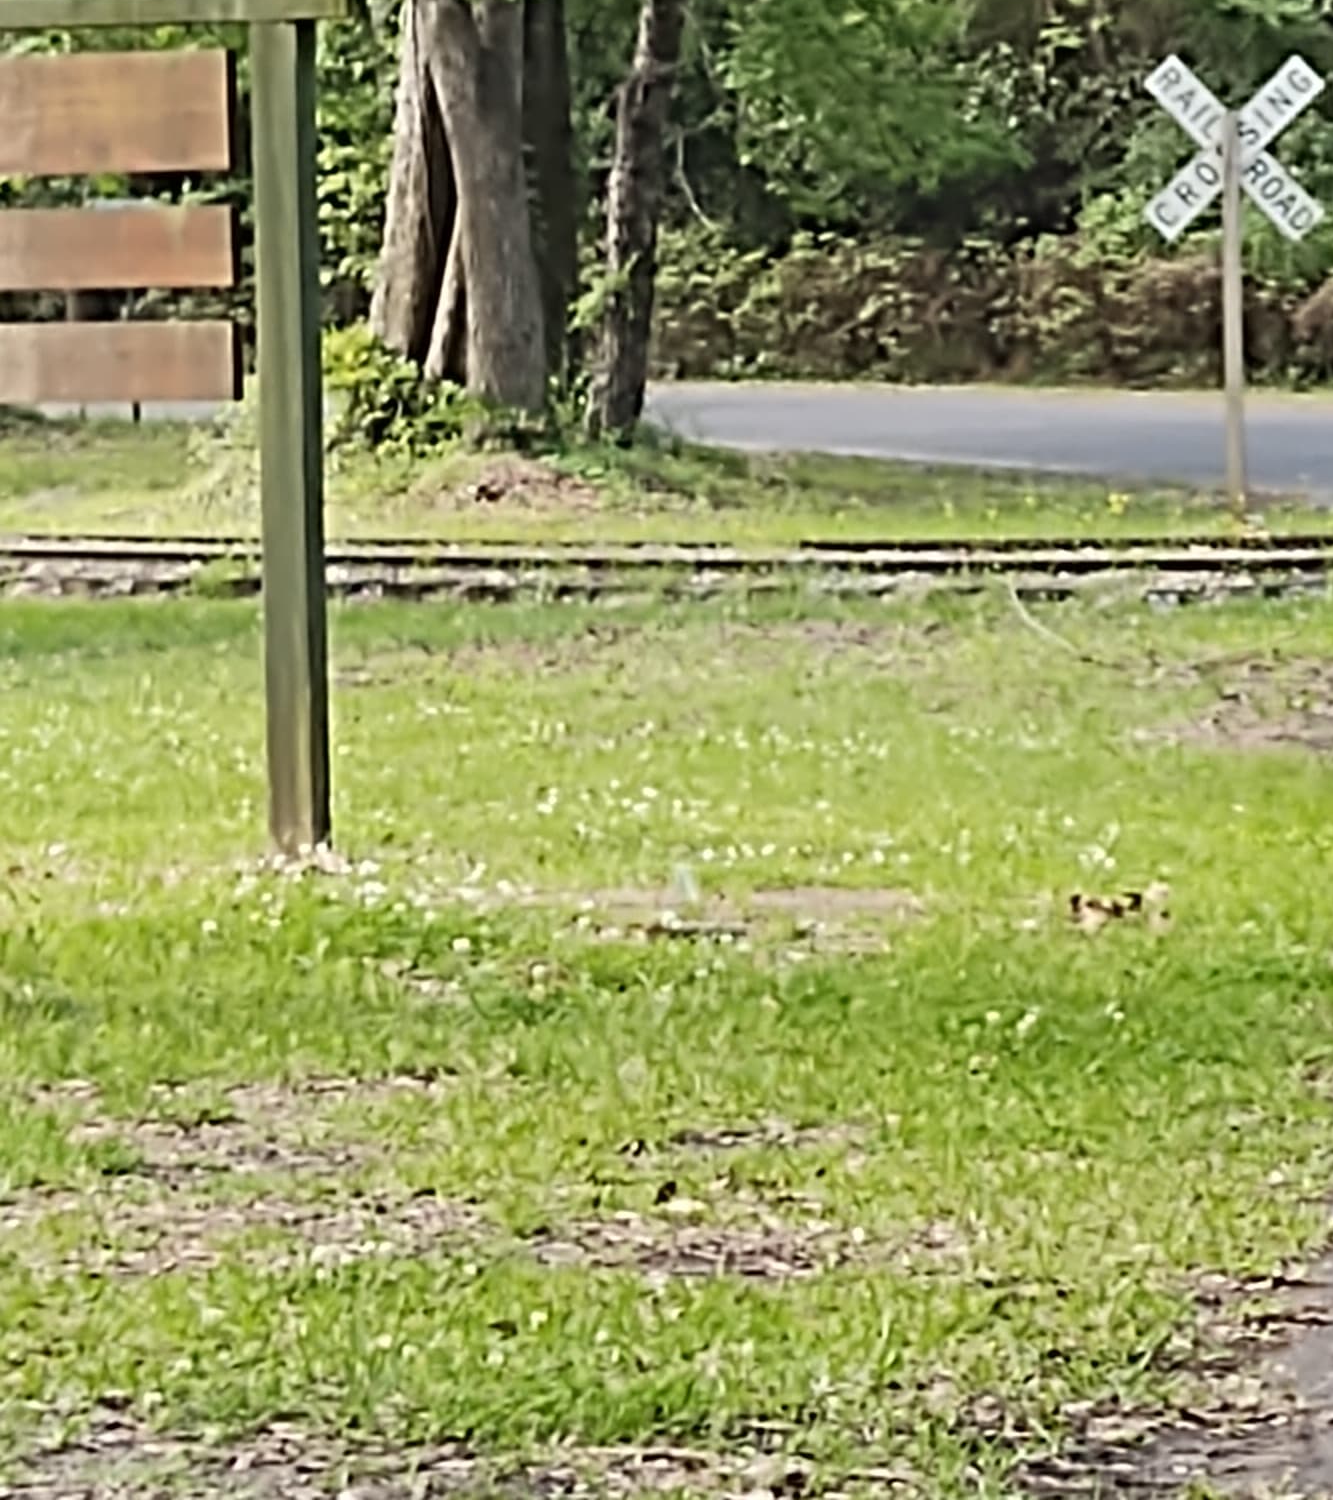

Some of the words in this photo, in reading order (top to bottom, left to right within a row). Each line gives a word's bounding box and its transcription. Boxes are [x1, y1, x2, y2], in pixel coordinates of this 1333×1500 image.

[1154, 66, 1221, 139] RAIL
[1241, 158, 1313, 230] ROAD
[1155, 69, 1312, 226] CROSING
